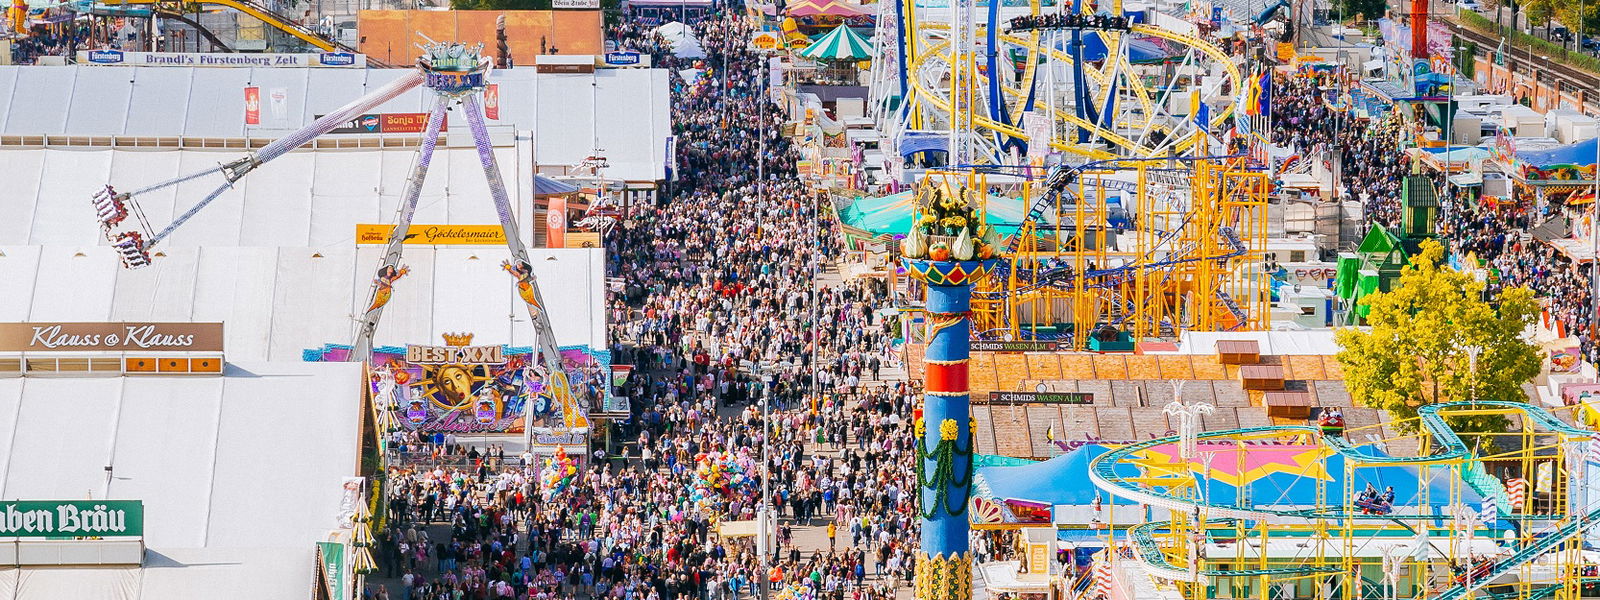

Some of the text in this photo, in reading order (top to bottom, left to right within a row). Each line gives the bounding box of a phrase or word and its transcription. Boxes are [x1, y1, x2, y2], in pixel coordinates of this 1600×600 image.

[91, 51, 121, 61] Fürstenberg
[145, 54, 298, 66] Brandl's Fürstenberg Zelt
[323, 53, 352, 63] Fürstenberg
[608, 54, 637, 63] Fürstenberg
[426, 73, 456, 88] BEST
[387, 115, 413, 126] Sonja
[424, 226, 503, 242] Göckelesmaier
[30, 325, 101, 348] Klauss
[123, 325, 194, 348] Klauss
[970, 341, 1046, 350] SCHMIDS WASEN ALM
[408, 345, 504, 363] BEST XXL
[1000, 394, 1036, 402] SCHMIDS
[1036, 394, 1063, 402] WASEN
[56, 503, 127, 533] Bräu
